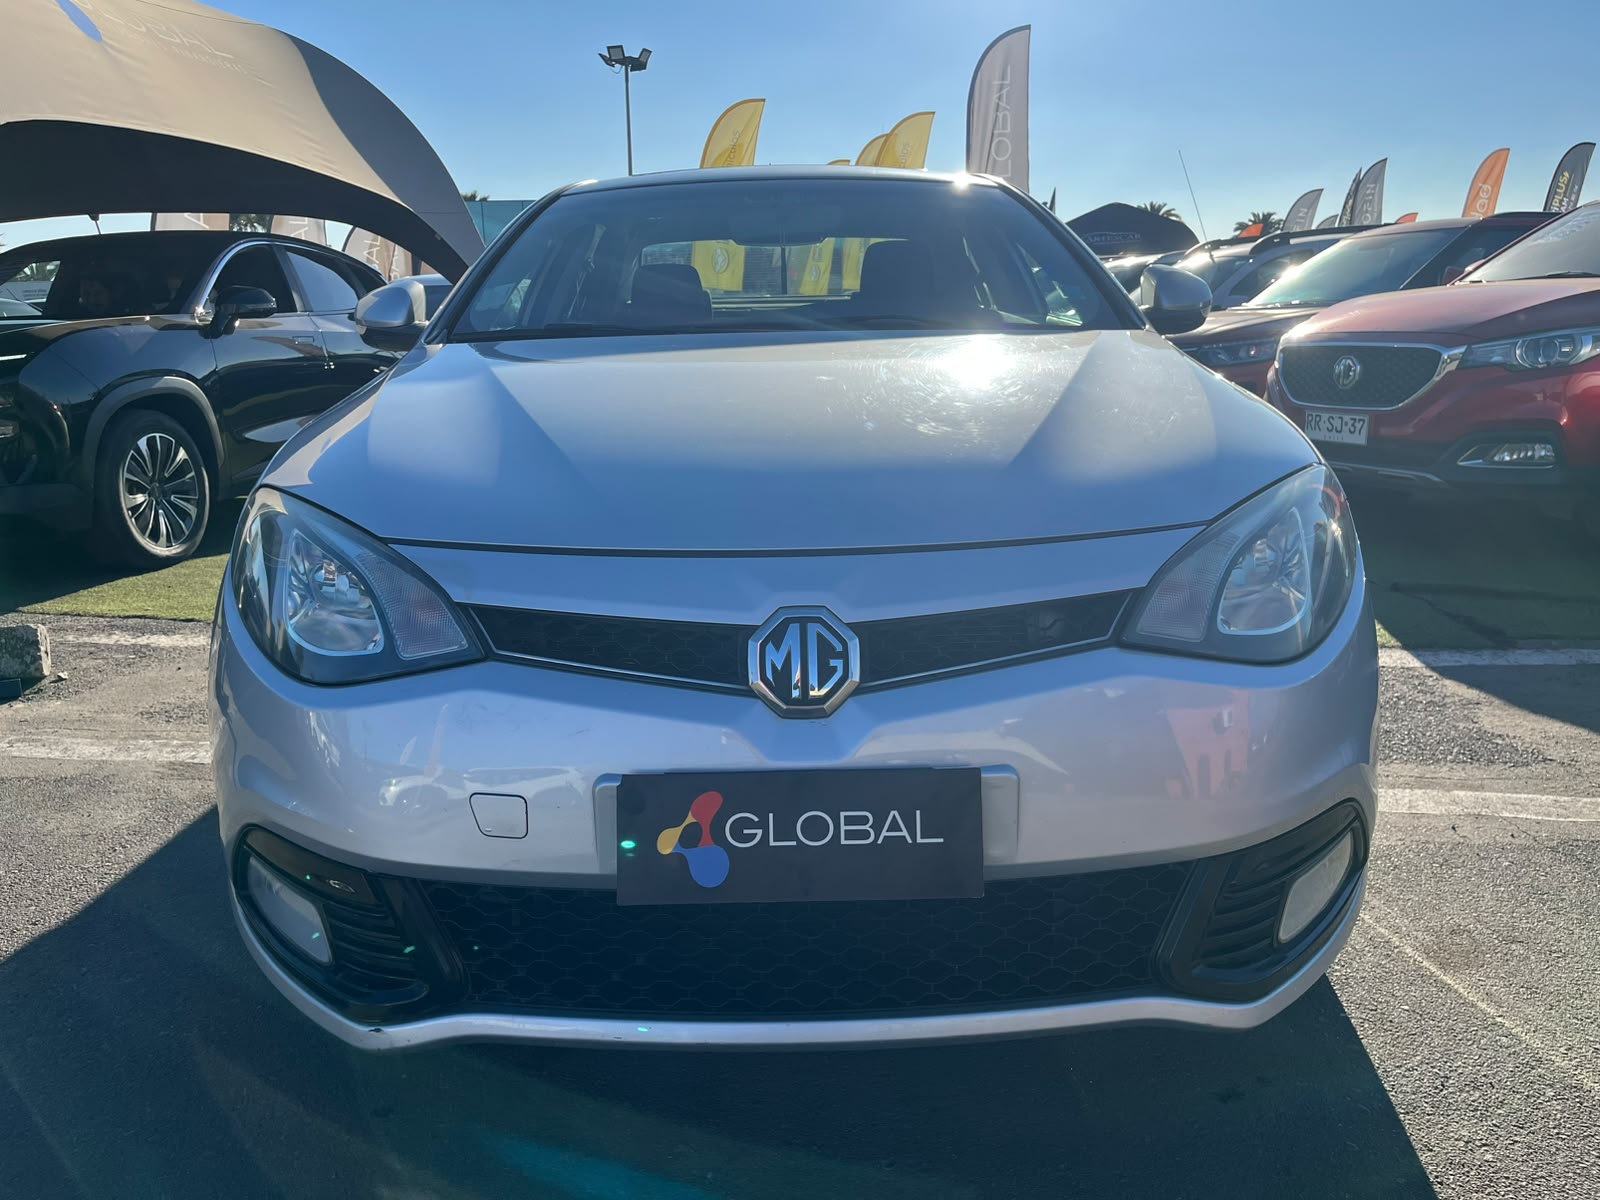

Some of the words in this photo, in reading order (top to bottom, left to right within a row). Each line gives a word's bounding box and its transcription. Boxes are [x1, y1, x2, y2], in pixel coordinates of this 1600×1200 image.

[991, 64, 1012, 178] LOBAL
[764, 622, 845, 699] MG
[724, 810, 944, 848] GLOBAL
